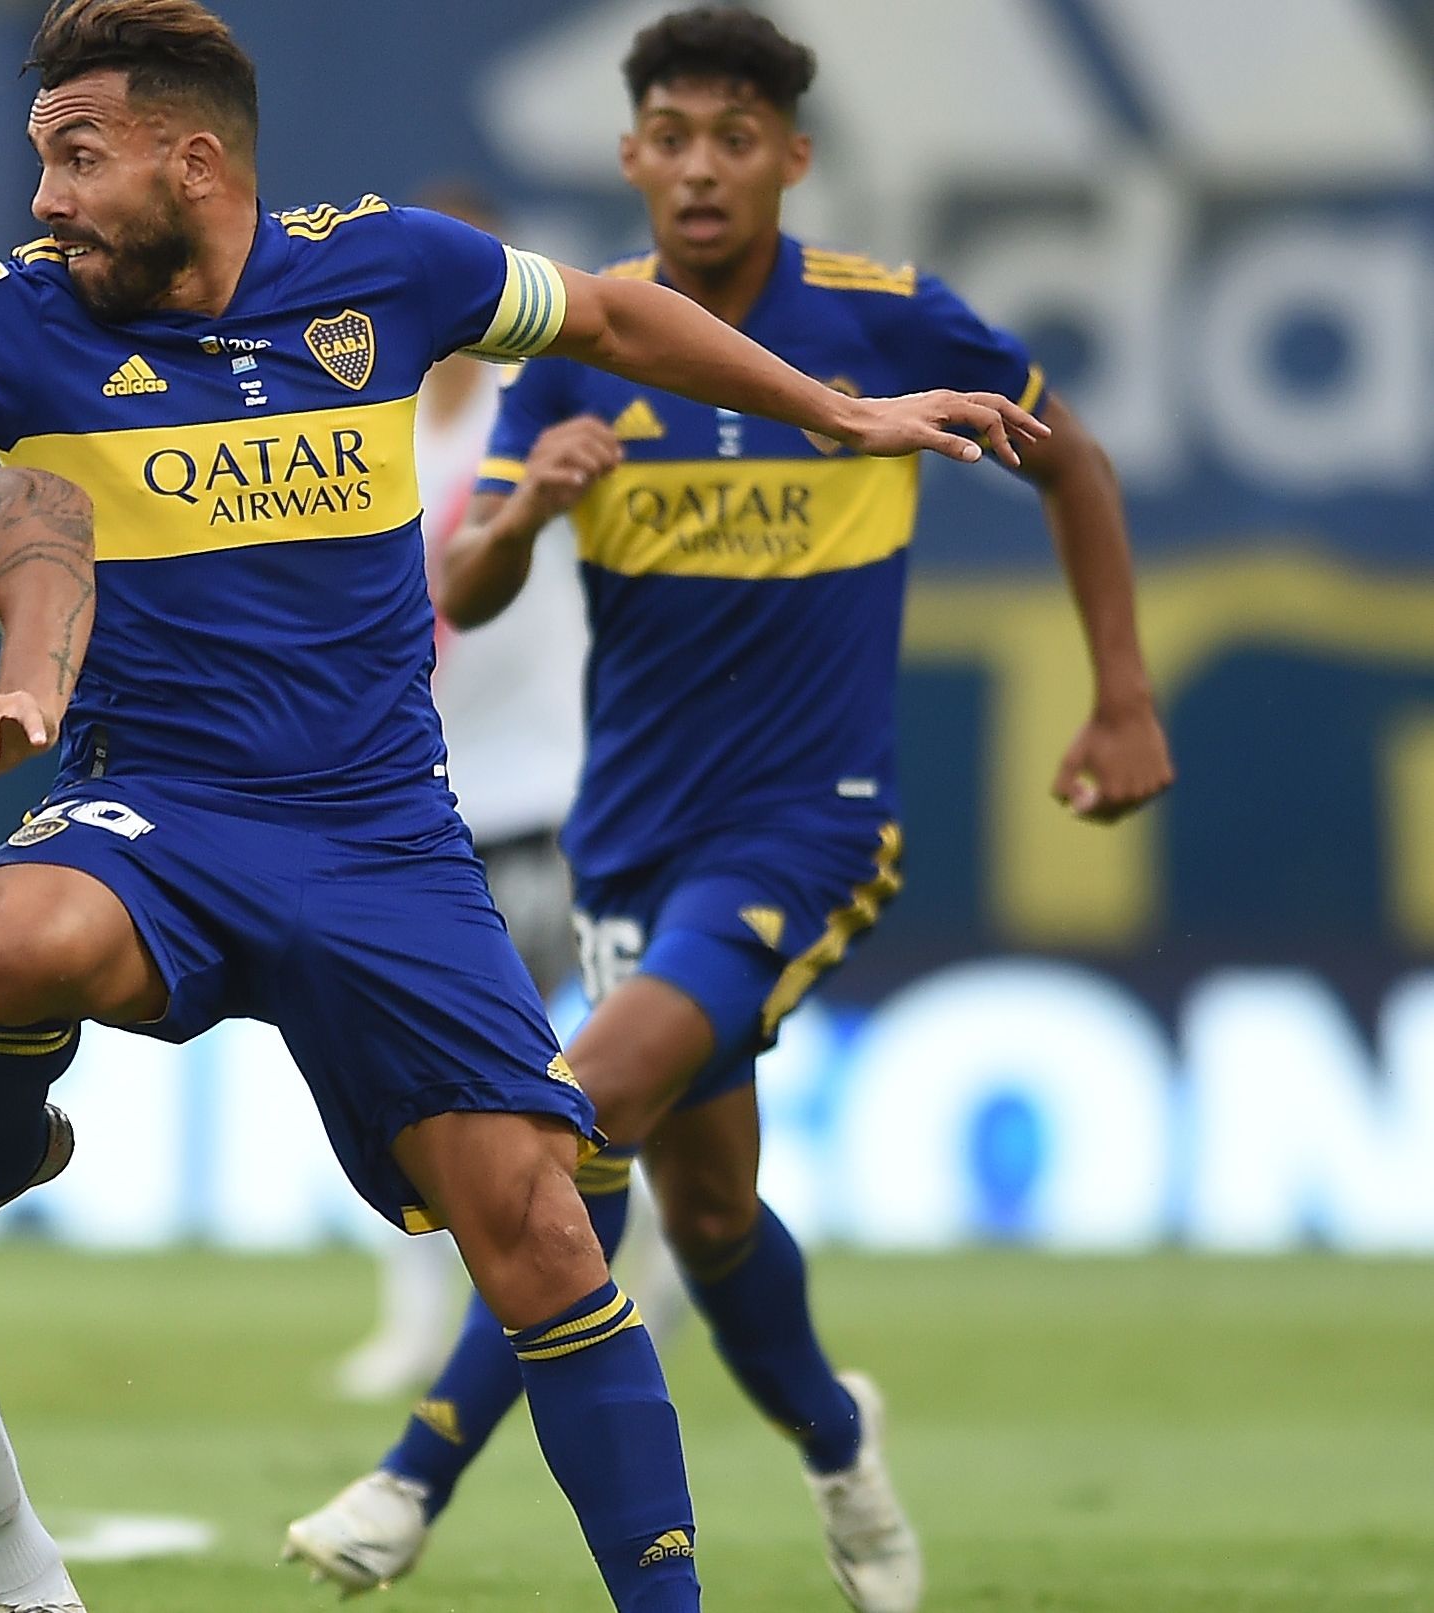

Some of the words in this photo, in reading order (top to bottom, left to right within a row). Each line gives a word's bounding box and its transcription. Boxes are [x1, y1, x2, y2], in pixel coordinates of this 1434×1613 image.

[319, 334, 367, 358] CABJ
[102, 379, 168, 397] adidas
[143, 429, 370, 505] QATAR
[209, 480, 372, 526] AIRWAYS
[626, 483, 811, 533] QATAR
